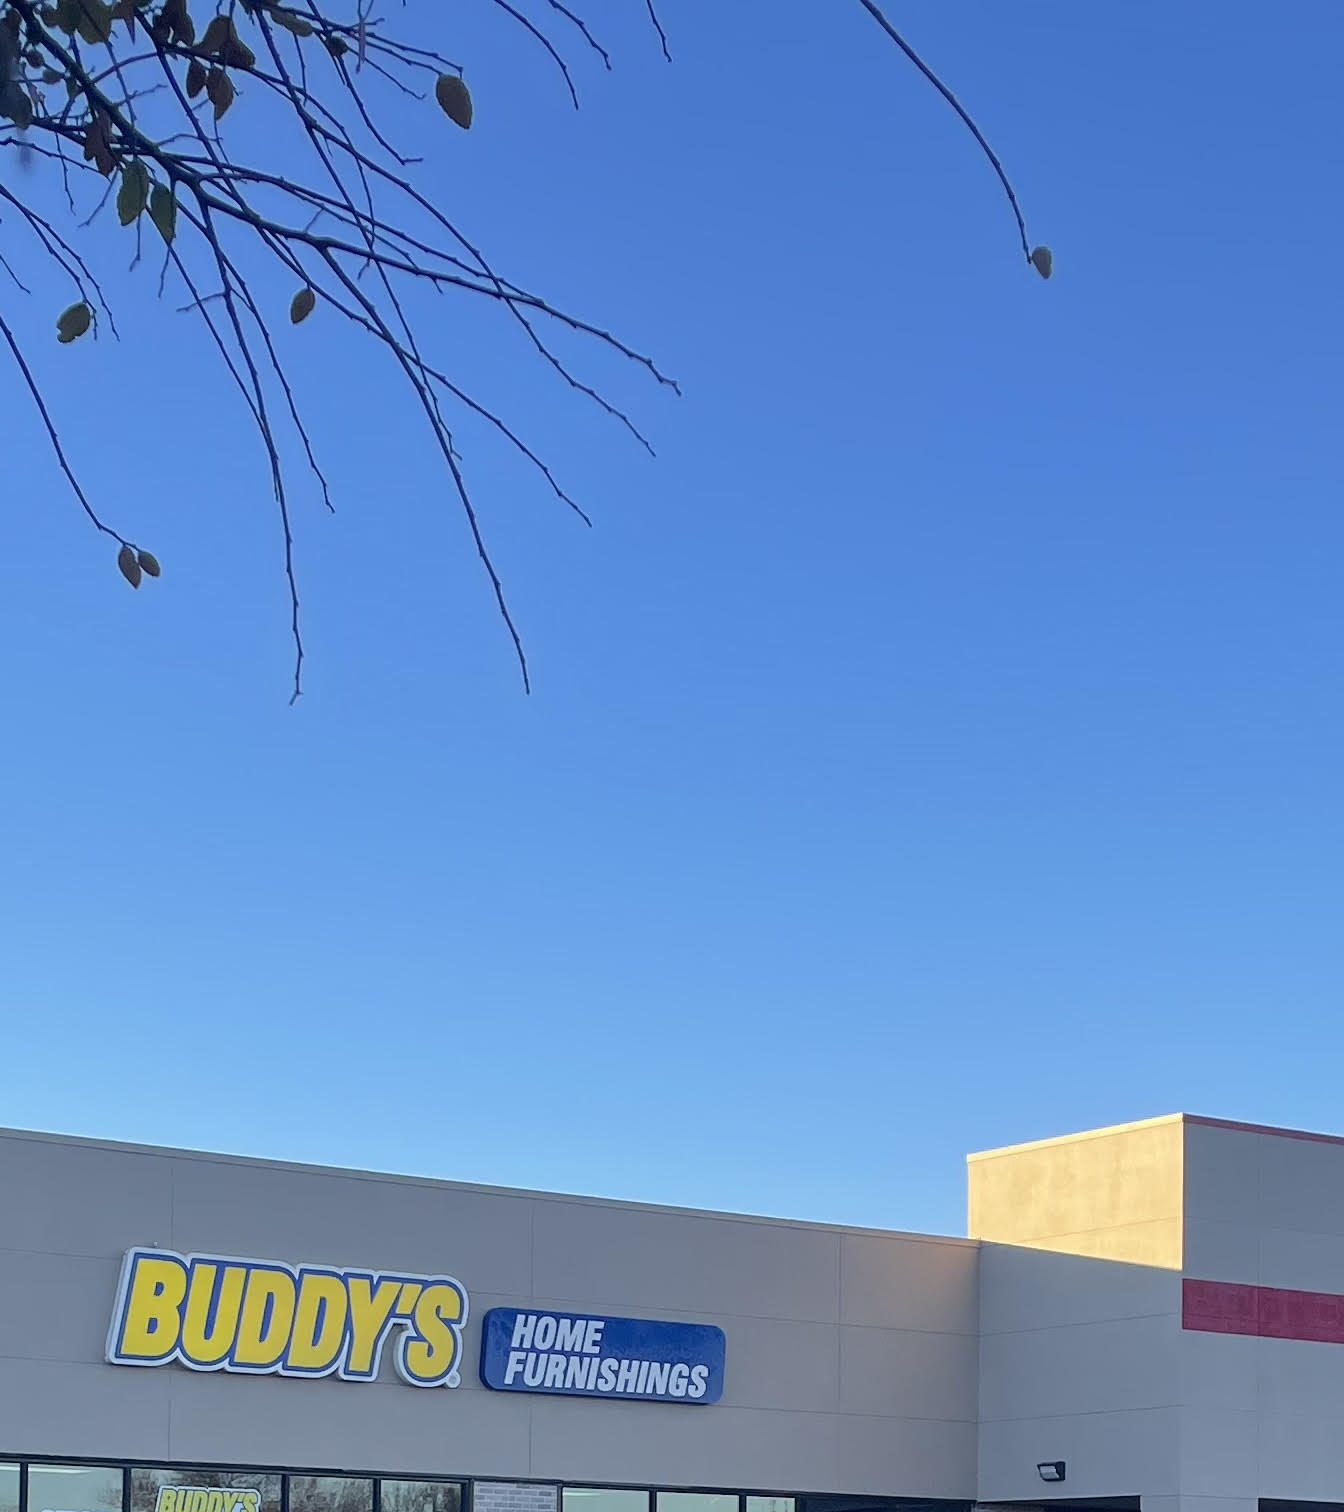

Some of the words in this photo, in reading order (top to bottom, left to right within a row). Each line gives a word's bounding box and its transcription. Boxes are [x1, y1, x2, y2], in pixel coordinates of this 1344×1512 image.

[119, 1256, 460, 1380] BUDDY'S
[511, 1314, 605, 1355] HOME
[503, 1353, 710, 1400] FURNISHINGS
